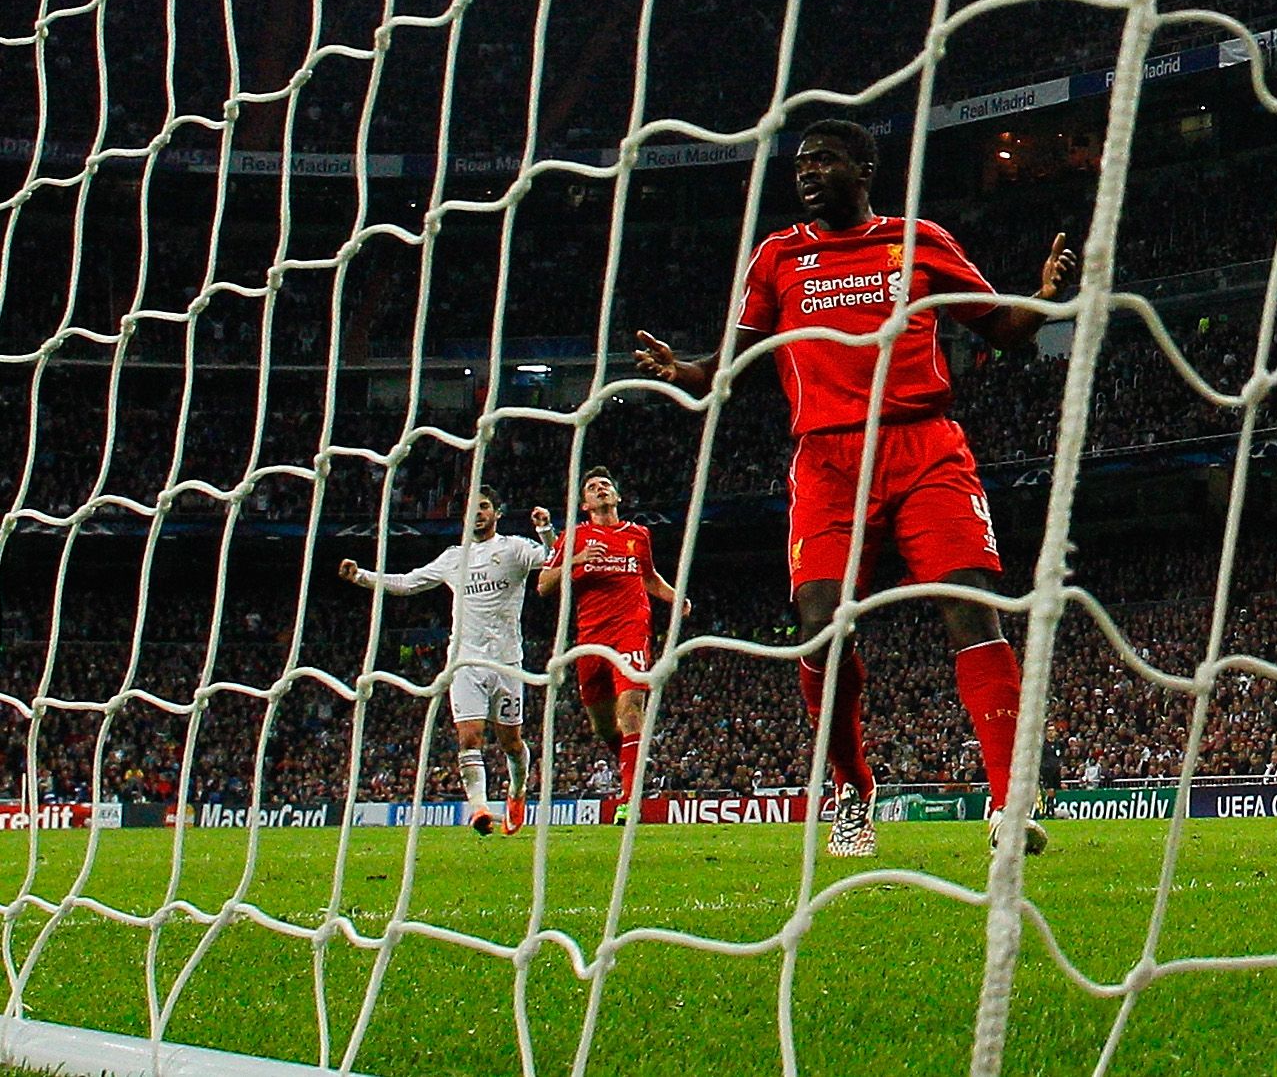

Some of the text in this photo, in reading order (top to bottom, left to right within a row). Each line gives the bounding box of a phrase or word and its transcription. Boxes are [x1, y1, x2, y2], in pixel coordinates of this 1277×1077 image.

[960, 90, 1035, 120] Real Madrid
[647, 144, 738, 165] Real Madrid
[803, 272, 882, 296] Standard
[801, 288, 884, 314] Chartered
[464, 579, 510, 595] mirates
[667, 798, 790, 824] NISSAN
[1053, 790, 1169, 819] esponsibly
[1216, 795, 1266, 818] UEFA
